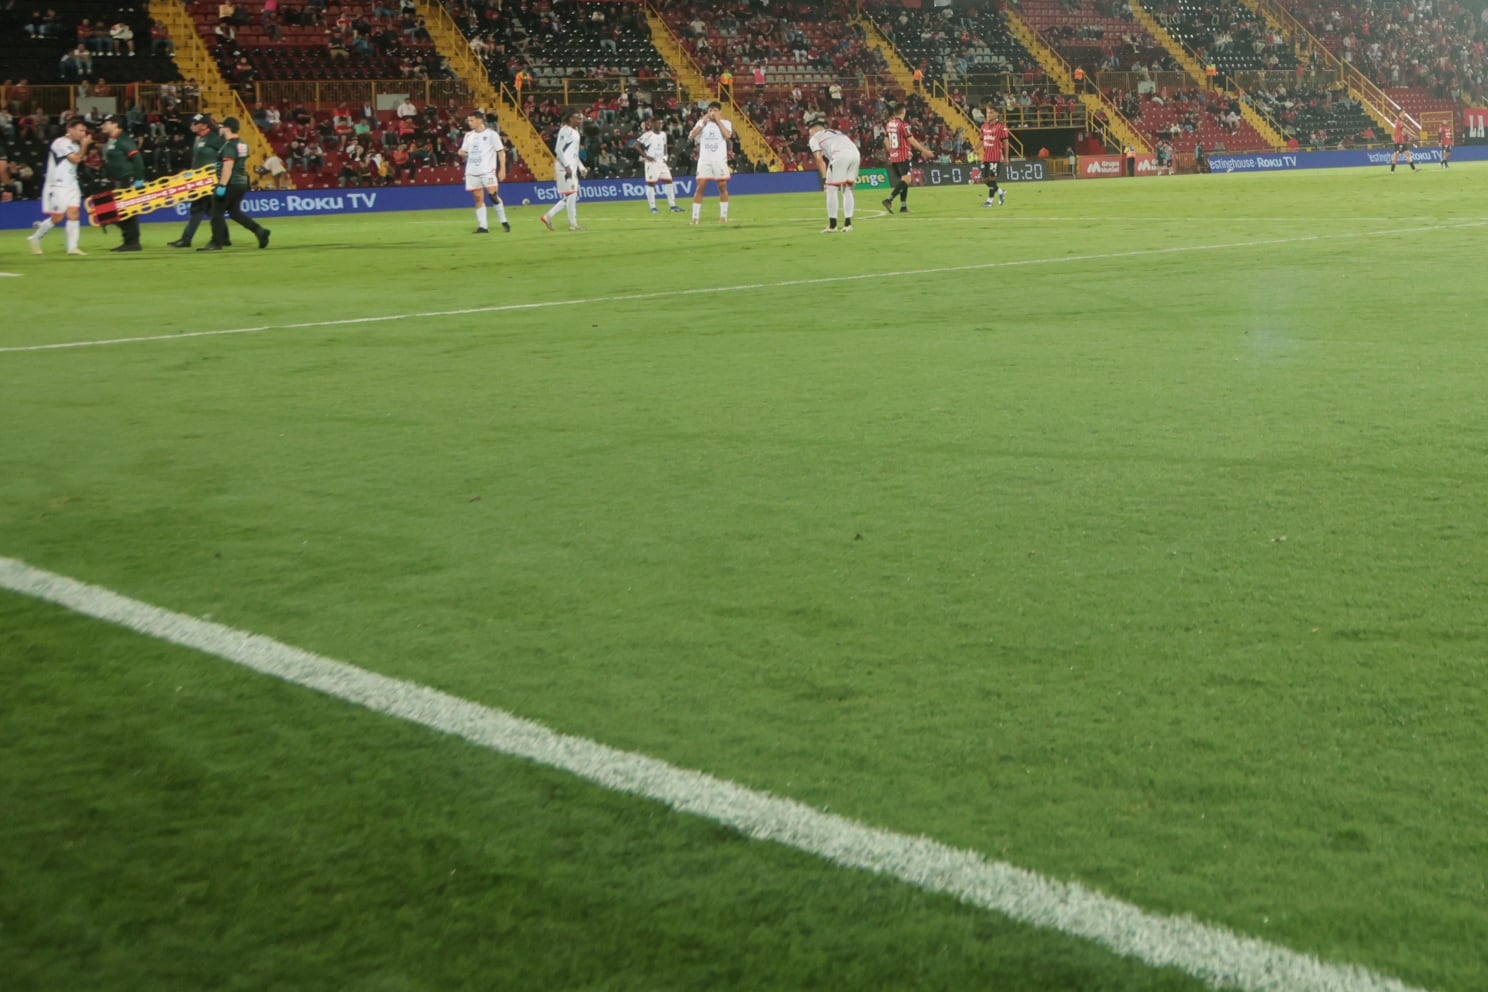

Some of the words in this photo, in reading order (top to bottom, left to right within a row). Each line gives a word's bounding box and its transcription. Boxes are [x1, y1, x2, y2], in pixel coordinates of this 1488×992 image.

[1469, 115, 1485, 138] LA
[1283, 156, 1297, 167] TV
[855, 173, 886, 187] onge
[1006, 163, 1043, 181] 16:20
[348, 192, 376, 209] TV
